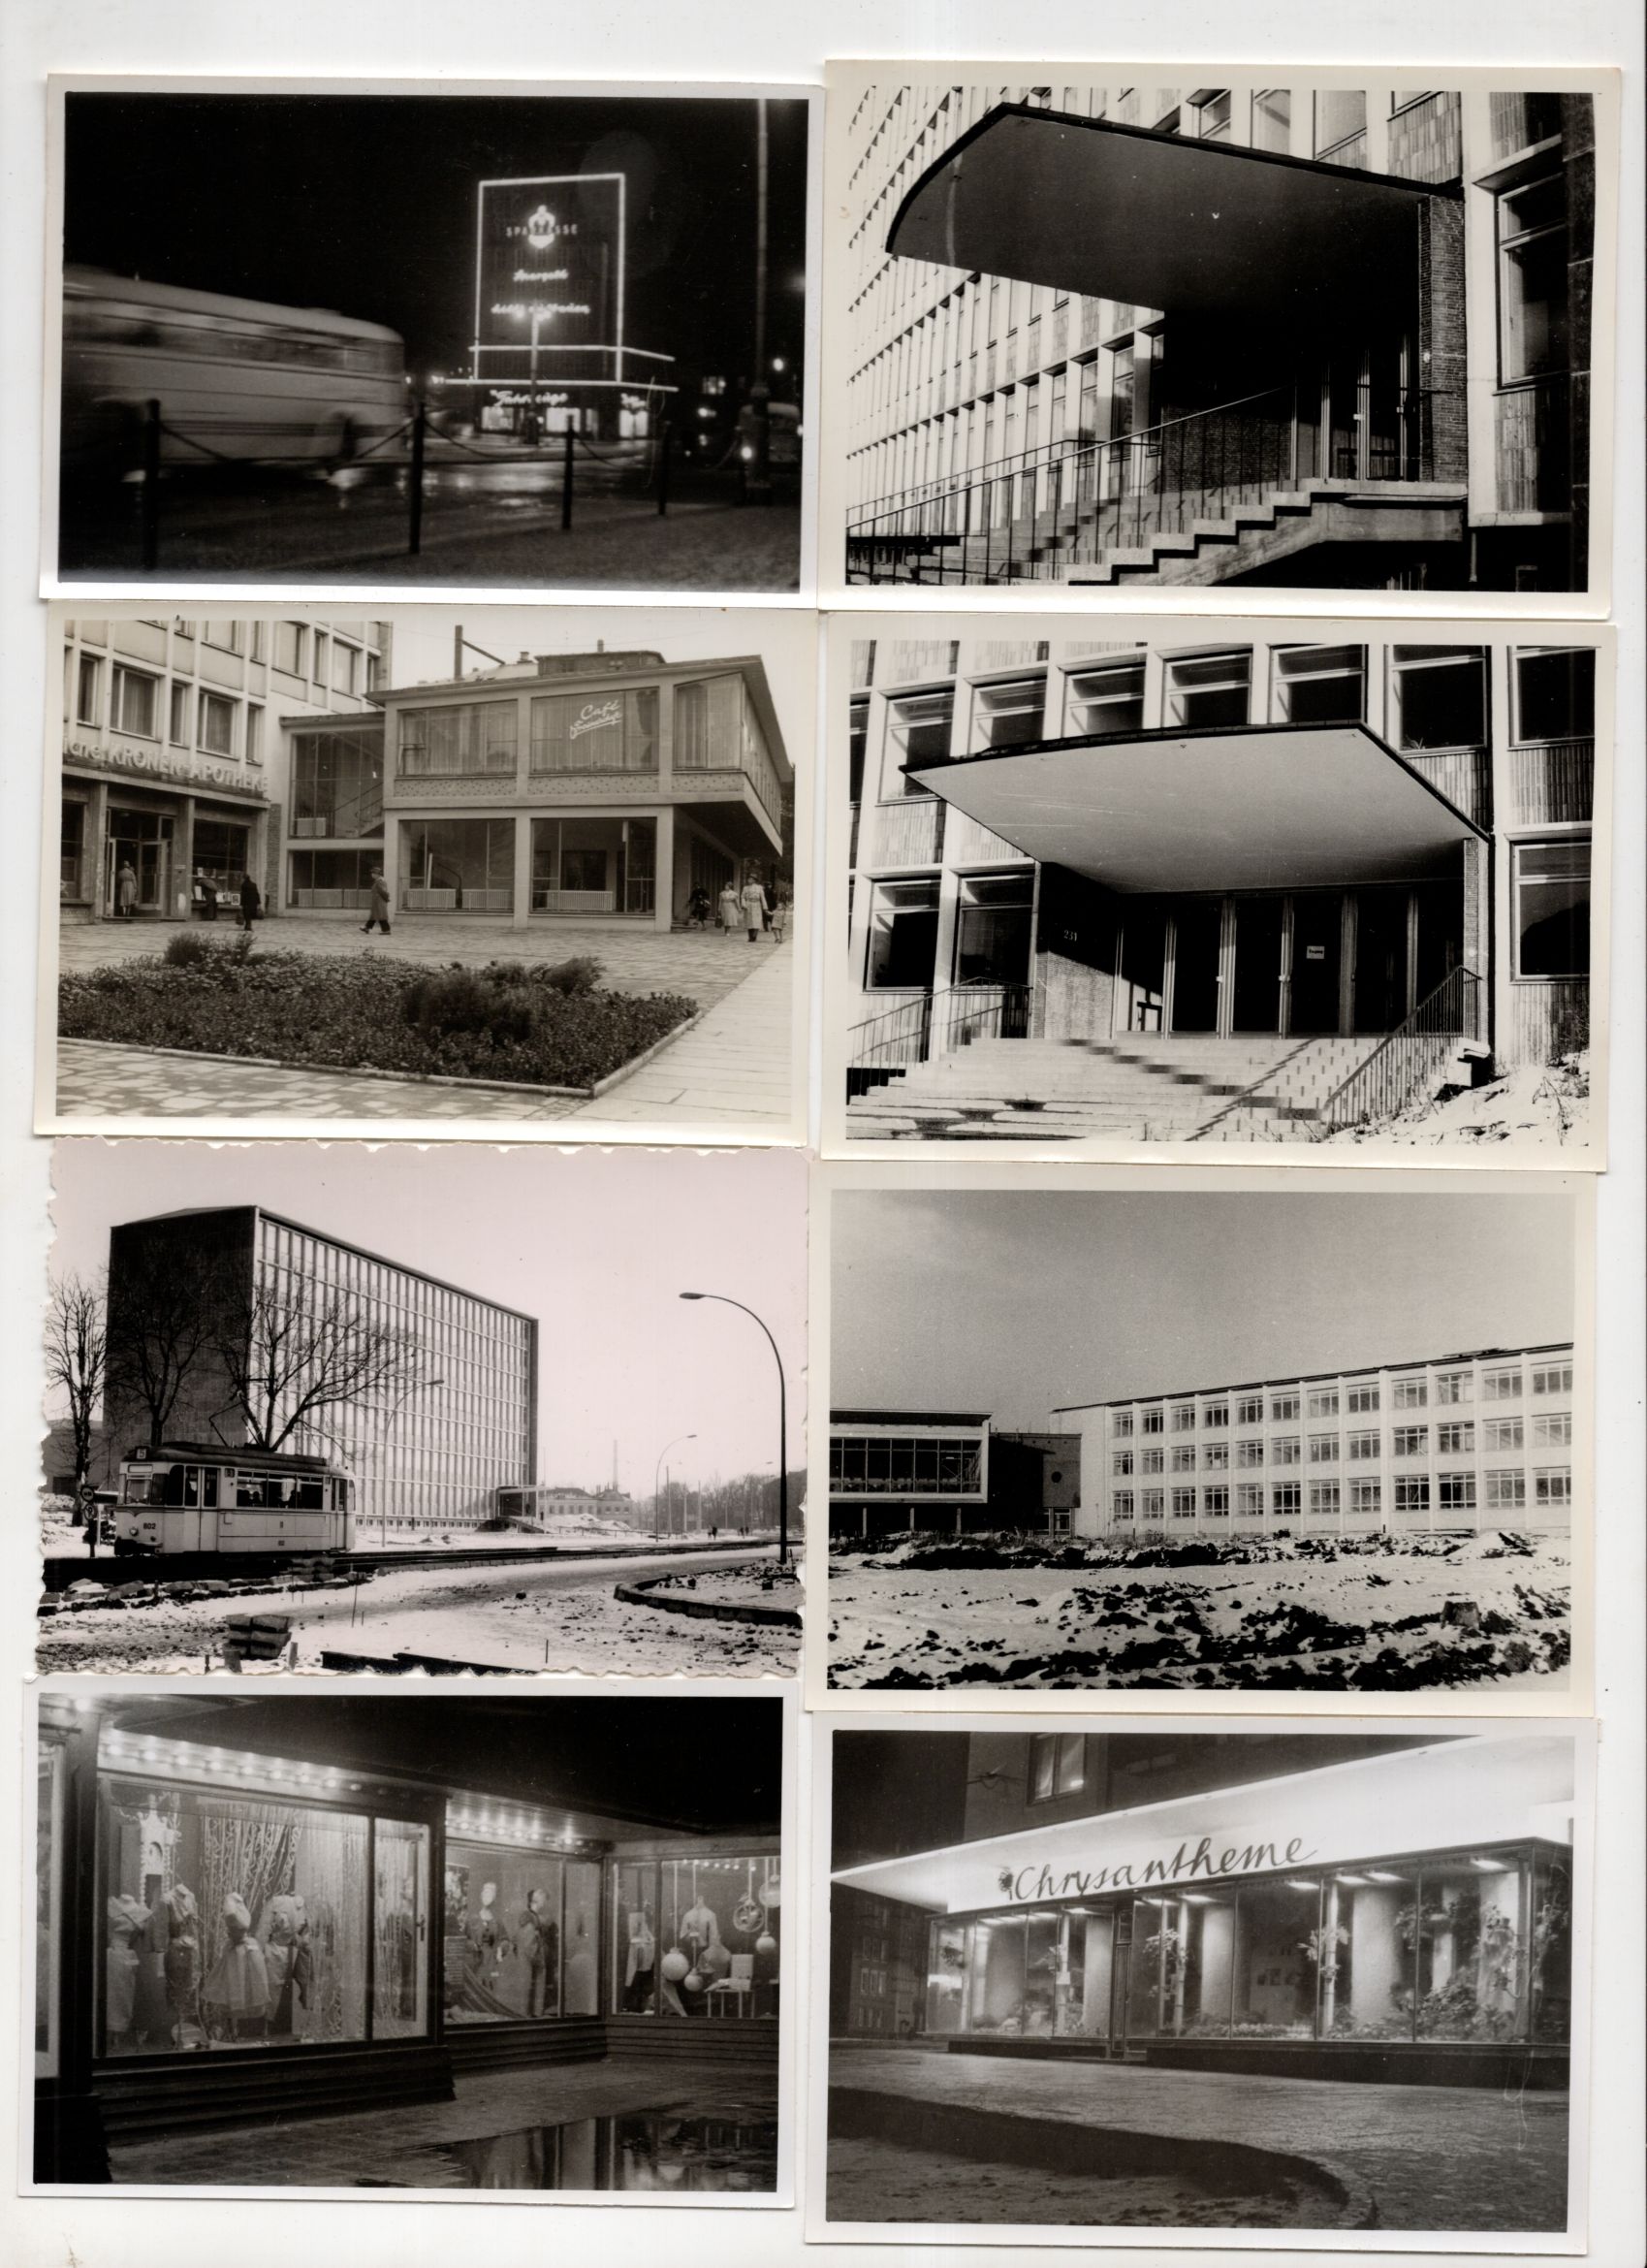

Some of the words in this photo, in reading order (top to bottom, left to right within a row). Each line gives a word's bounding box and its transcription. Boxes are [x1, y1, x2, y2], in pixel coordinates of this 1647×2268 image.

[505, 223, 578, 238] SPASSE
[581, 699, 620, 720] Café
[1015, 1837, 1318, 1901] Chrysantheme
